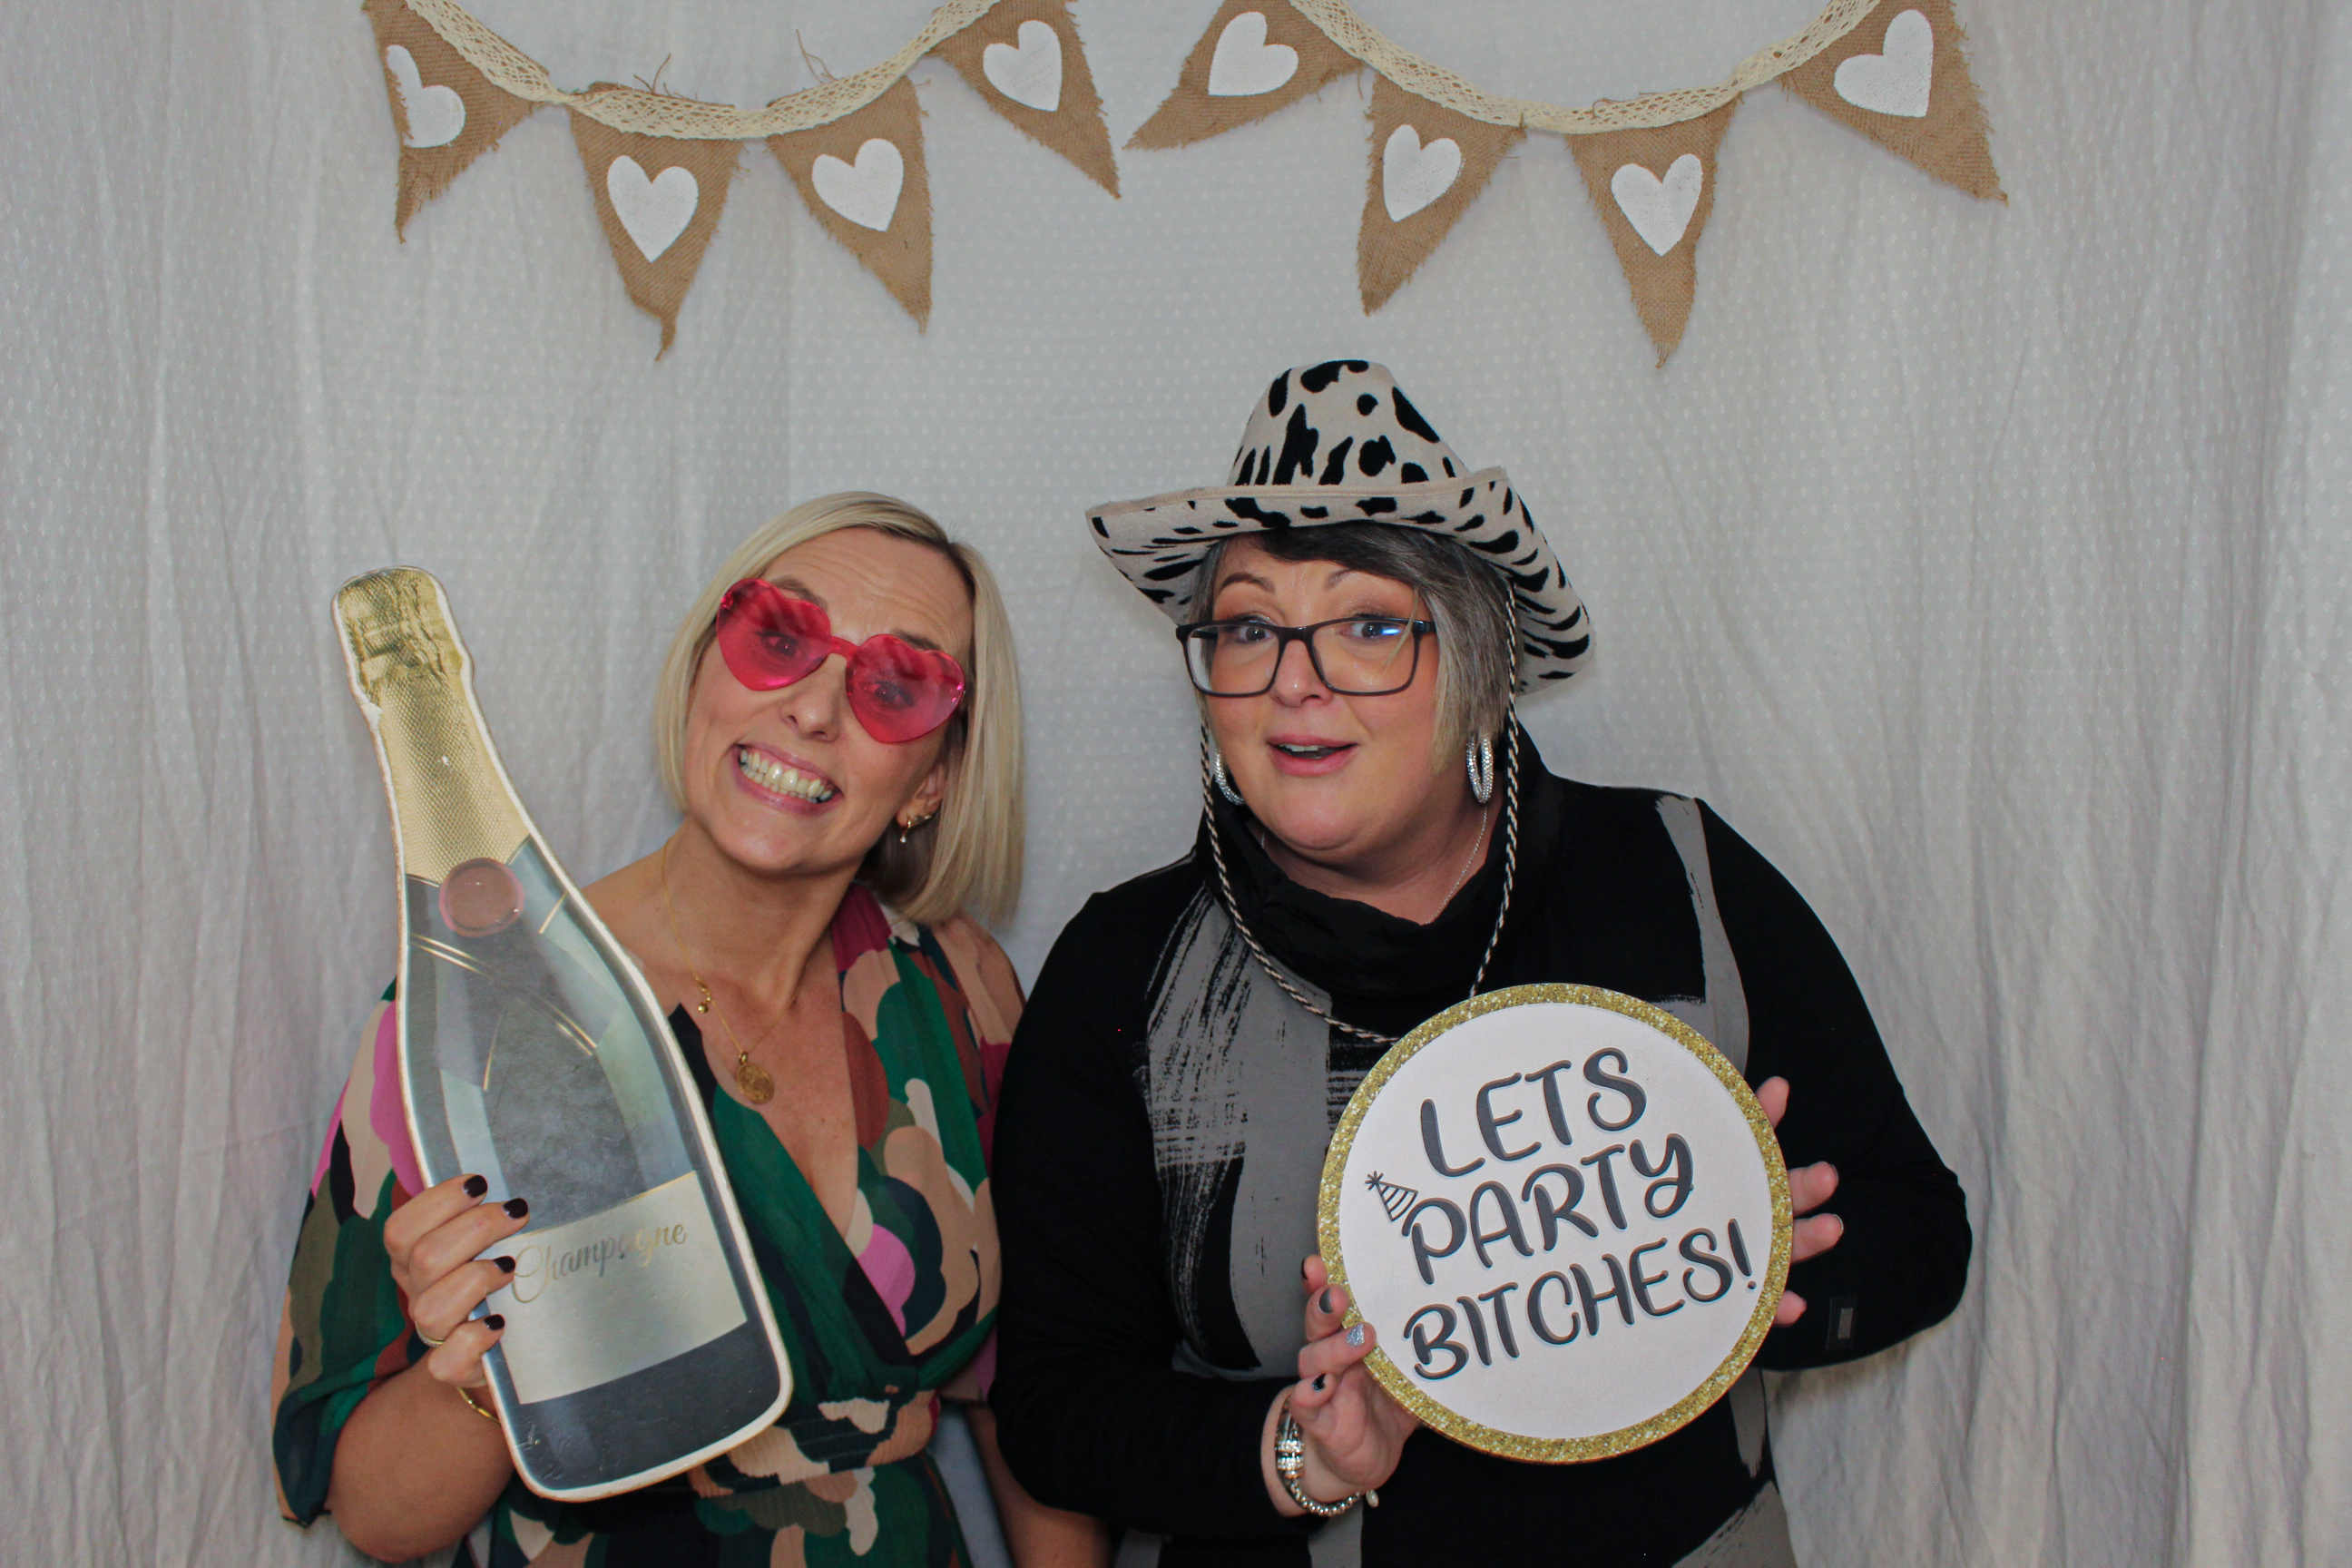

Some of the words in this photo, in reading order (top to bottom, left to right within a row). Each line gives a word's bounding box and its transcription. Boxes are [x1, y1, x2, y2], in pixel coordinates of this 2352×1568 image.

[1421, 1047, 1647, 1177] LETS
[513, 1224, 687, 1303] Champagne
[1402, 1134, 1693, 1285] PARTY
[1404, 1219, 1757, 1379] BITCHES!
